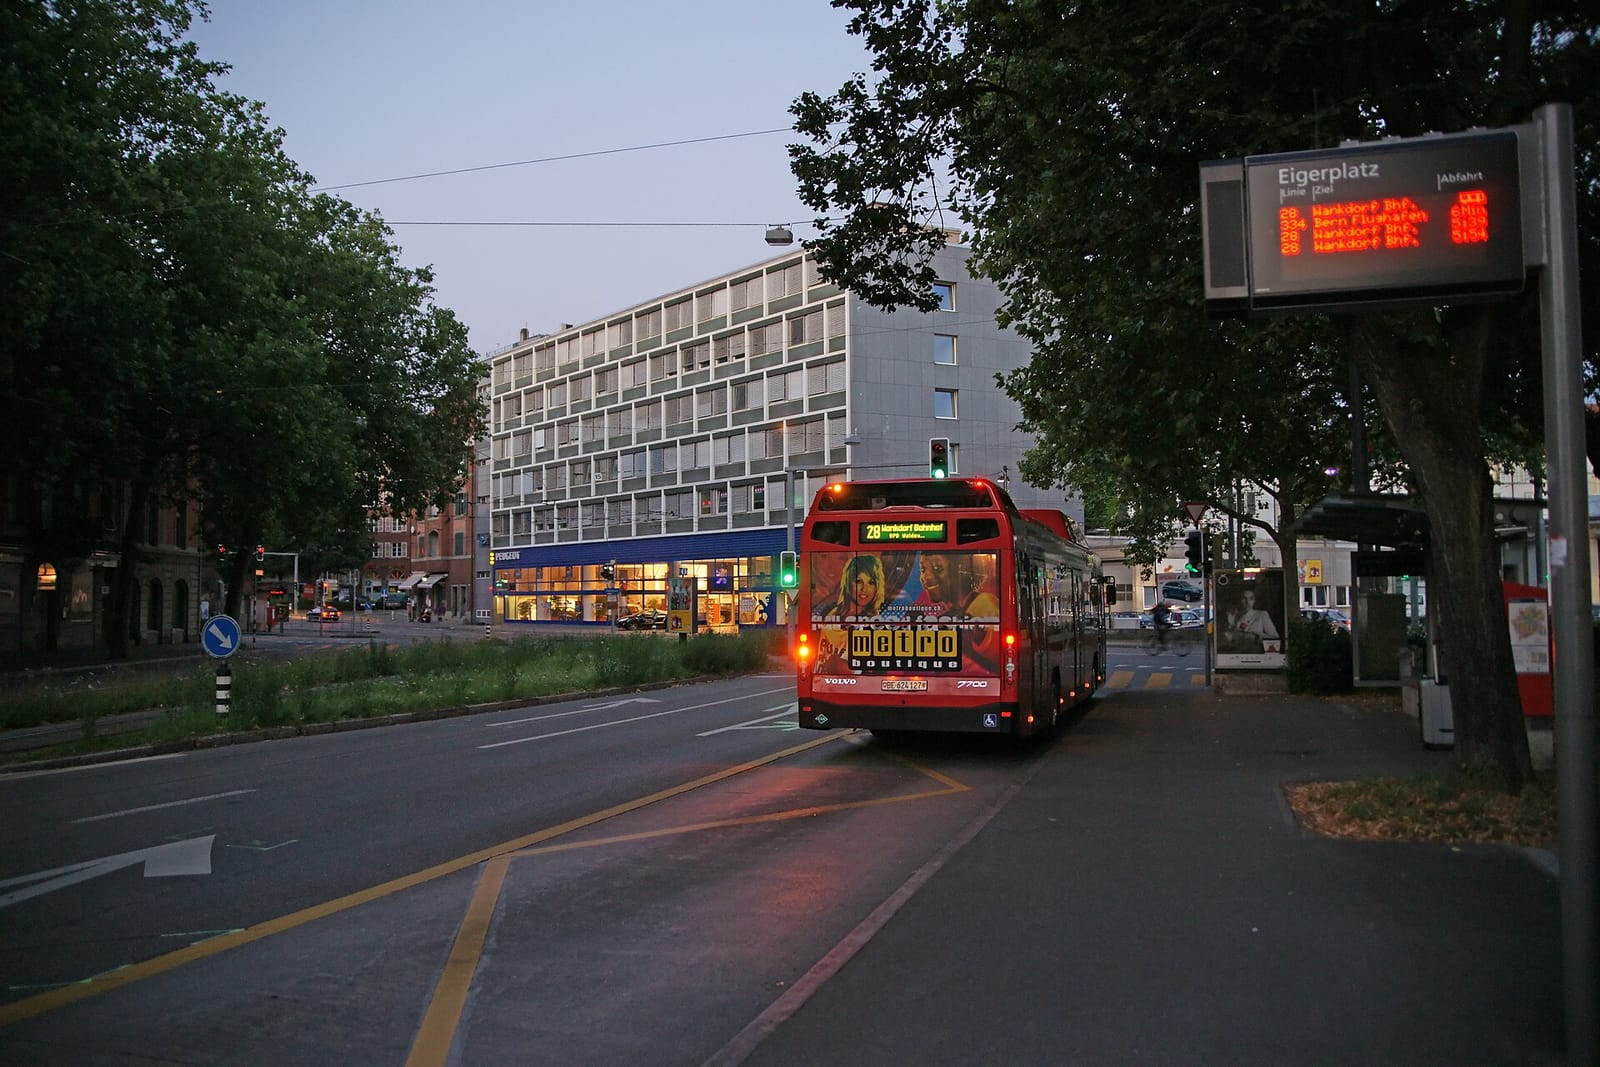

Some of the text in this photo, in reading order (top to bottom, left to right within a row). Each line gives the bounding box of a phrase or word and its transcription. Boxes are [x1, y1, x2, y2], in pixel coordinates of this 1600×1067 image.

[1278, 162, 1380, 187] Eigerplatz
[1440, 171, 1484, 184] Abfahrt
[1282, 187, 1306, 198] Linie
[1315, 184, 1334, 194] Ziel
[1280, 208, 1298, 220] 28
[1313, 201, 1380, 217] Wankdorf
[1280, 218, 1306, 230] 334
[1314, 216, 1348, 229] Bern
[1281, 231, 1299, 243] 28
[1313, 225, 1381, 240] Wankdorf
[1281, 242, 1299, 255] 28
[1314, 237, 1382, 252] Wankdorf
[866, 523, 944, 539] 28 Wankdorf Bahnhof
[495, 551, 520, 561] PEUGEOT
[887, 604, 942, 612] metroboutique.ch
[853, 631, 957, 656] metro
[852, 658, 958, 669] boutique
[957, 680, 988, 688] 7700
